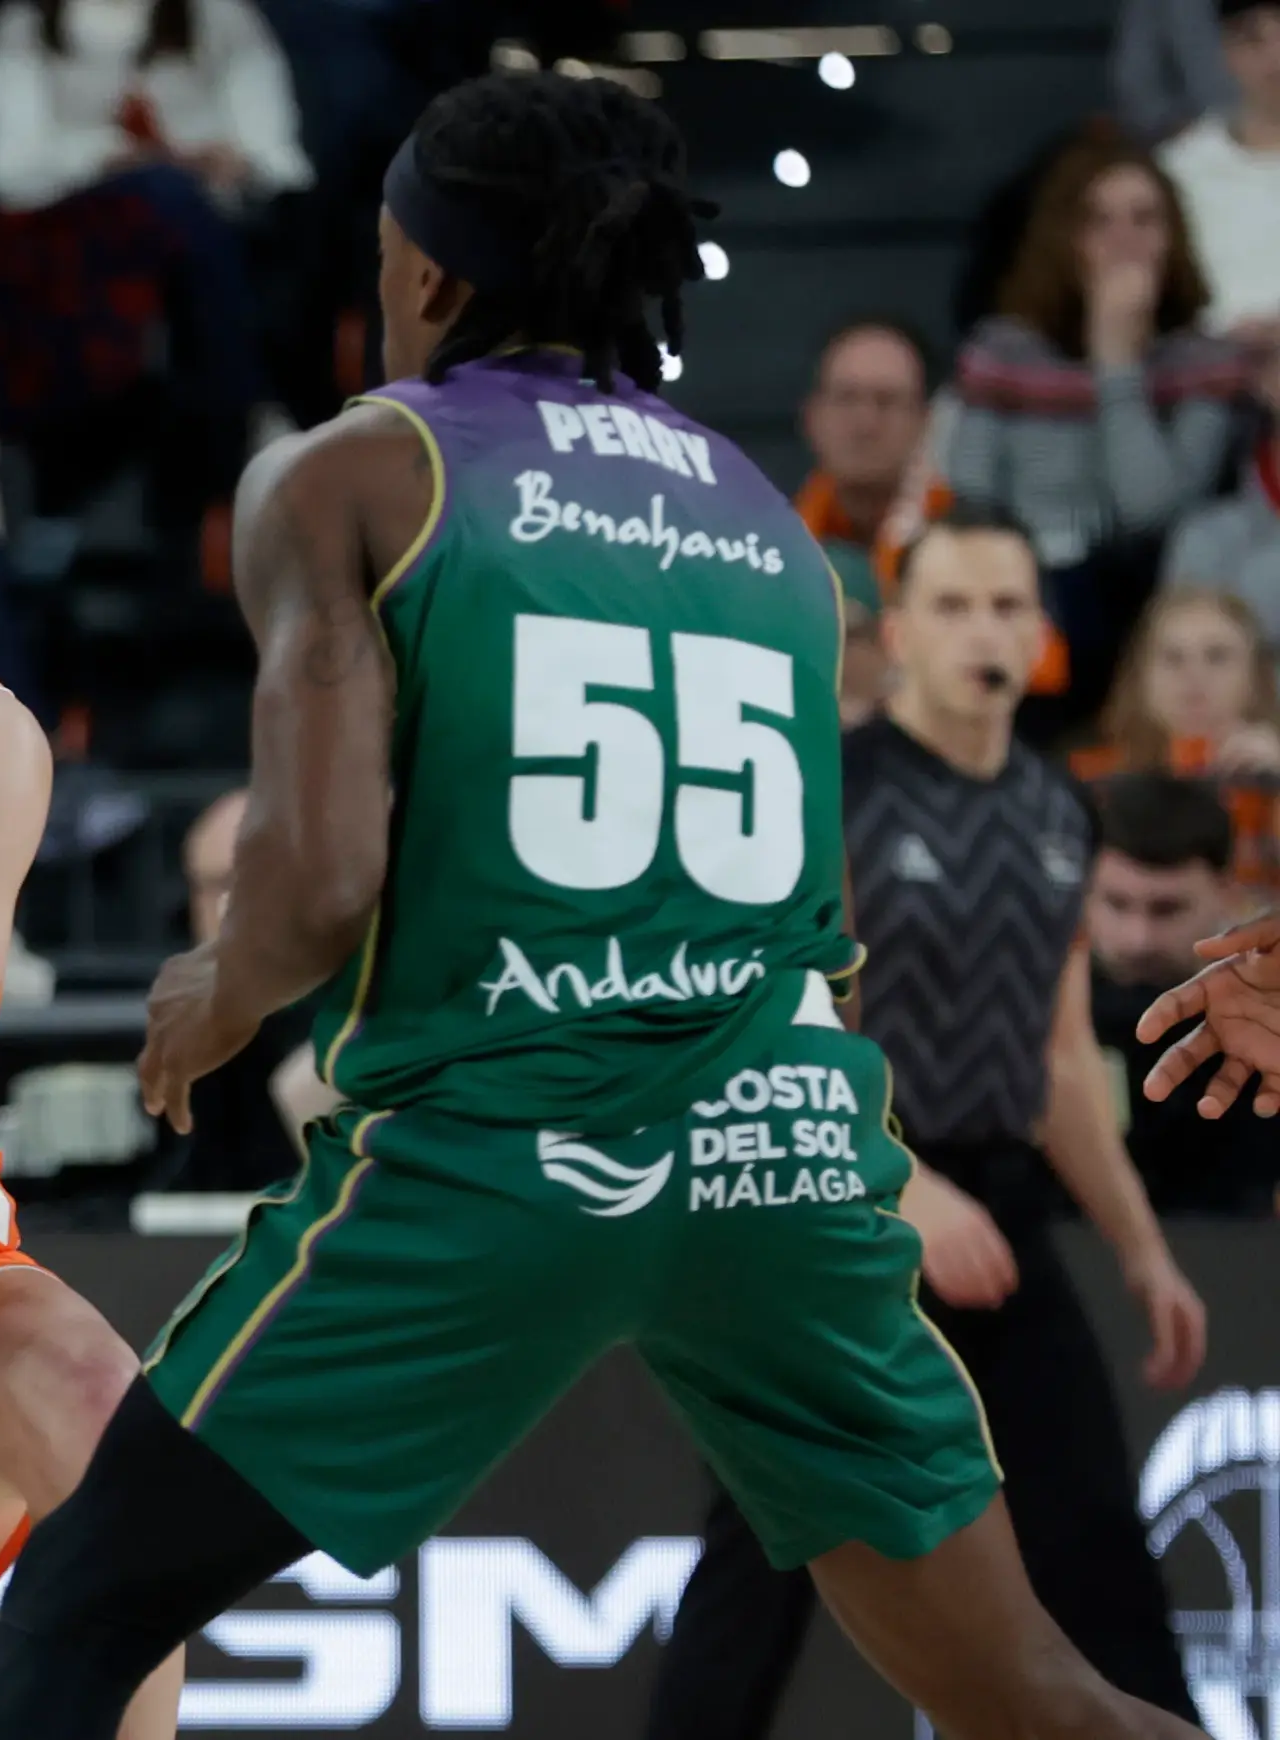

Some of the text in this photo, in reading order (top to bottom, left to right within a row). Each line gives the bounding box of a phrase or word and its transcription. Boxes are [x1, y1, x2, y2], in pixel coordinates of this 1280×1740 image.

[536, 399, 718, 485] PERRY
[508, 612, 805, 905] 55
[478, 935, 766, 1017] Andalucí
[690, 1117, 858, 1167] DEL SOL
[689, 1162, 867, 1212] MÁLAGA
